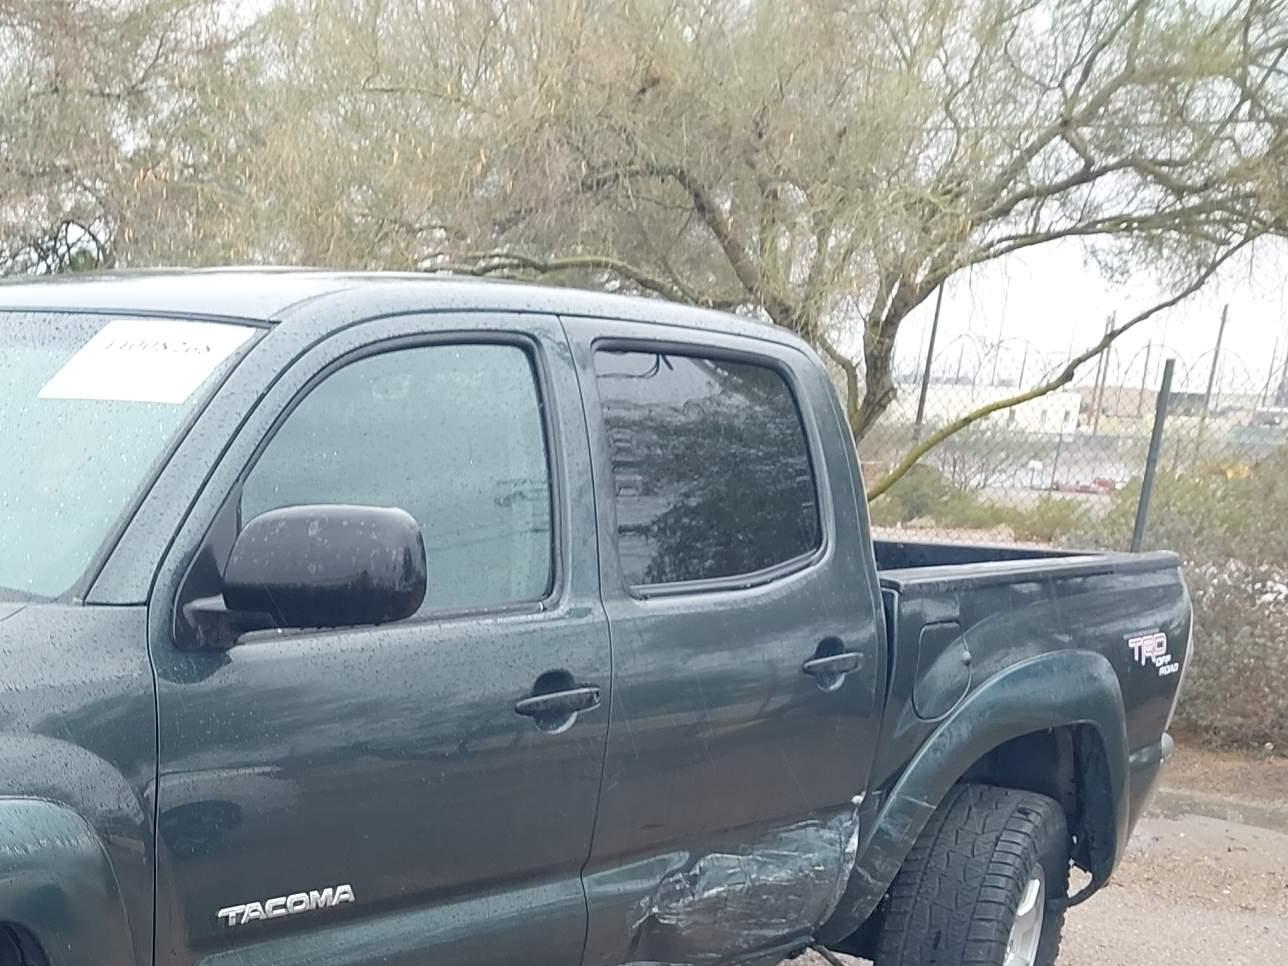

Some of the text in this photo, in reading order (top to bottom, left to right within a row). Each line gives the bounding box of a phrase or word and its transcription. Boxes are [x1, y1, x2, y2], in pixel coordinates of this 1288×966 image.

[1128, 632, 1167, 666] TRD
[1158, 662, 1179, 676] ROAD
[217, 884, 356, 927] TACOMA
